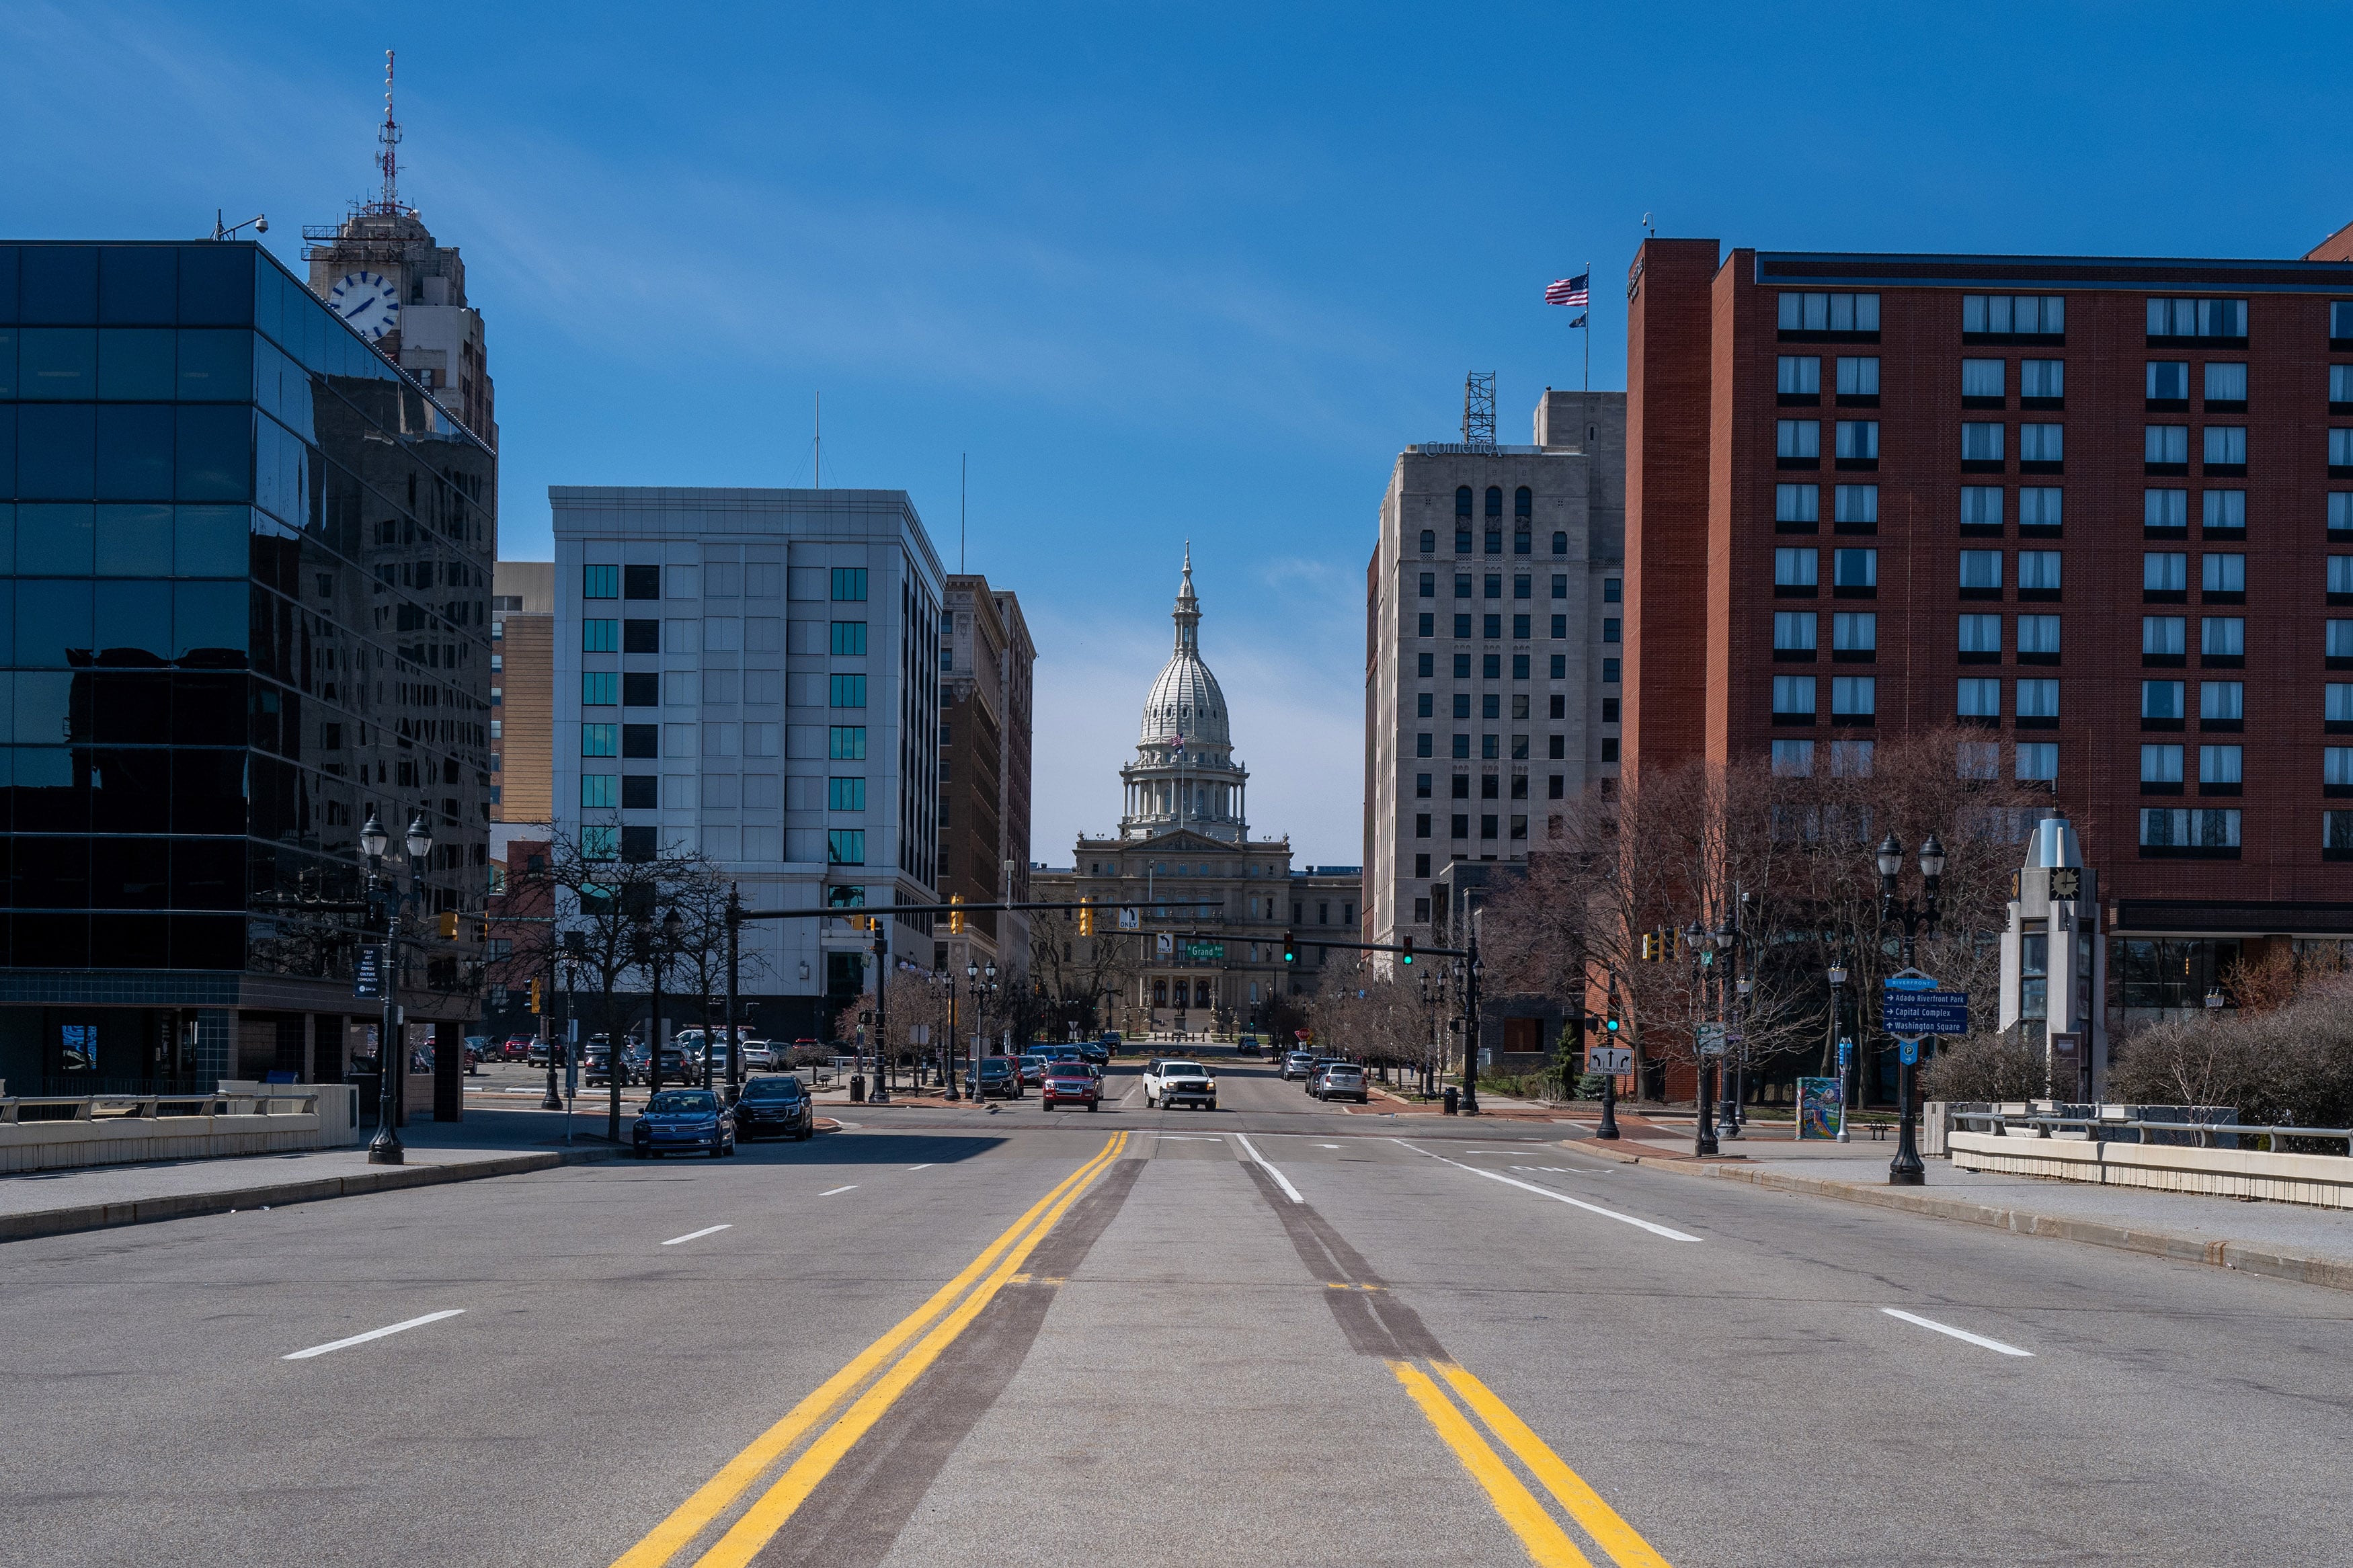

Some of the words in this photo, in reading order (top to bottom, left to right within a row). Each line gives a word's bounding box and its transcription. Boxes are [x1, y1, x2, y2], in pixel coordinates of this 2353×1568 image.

[1192, 946, 1213, 956] Grand
[1895, 1008, 1919, 1017] Capital
[1922, 1009, 1950, 1018] Complex
[1895, 1022, 1934, 1032] Washington
[1937, 1023, 1960, 1032] Square
[1509, 1165, 1614, 1173] ONLY
